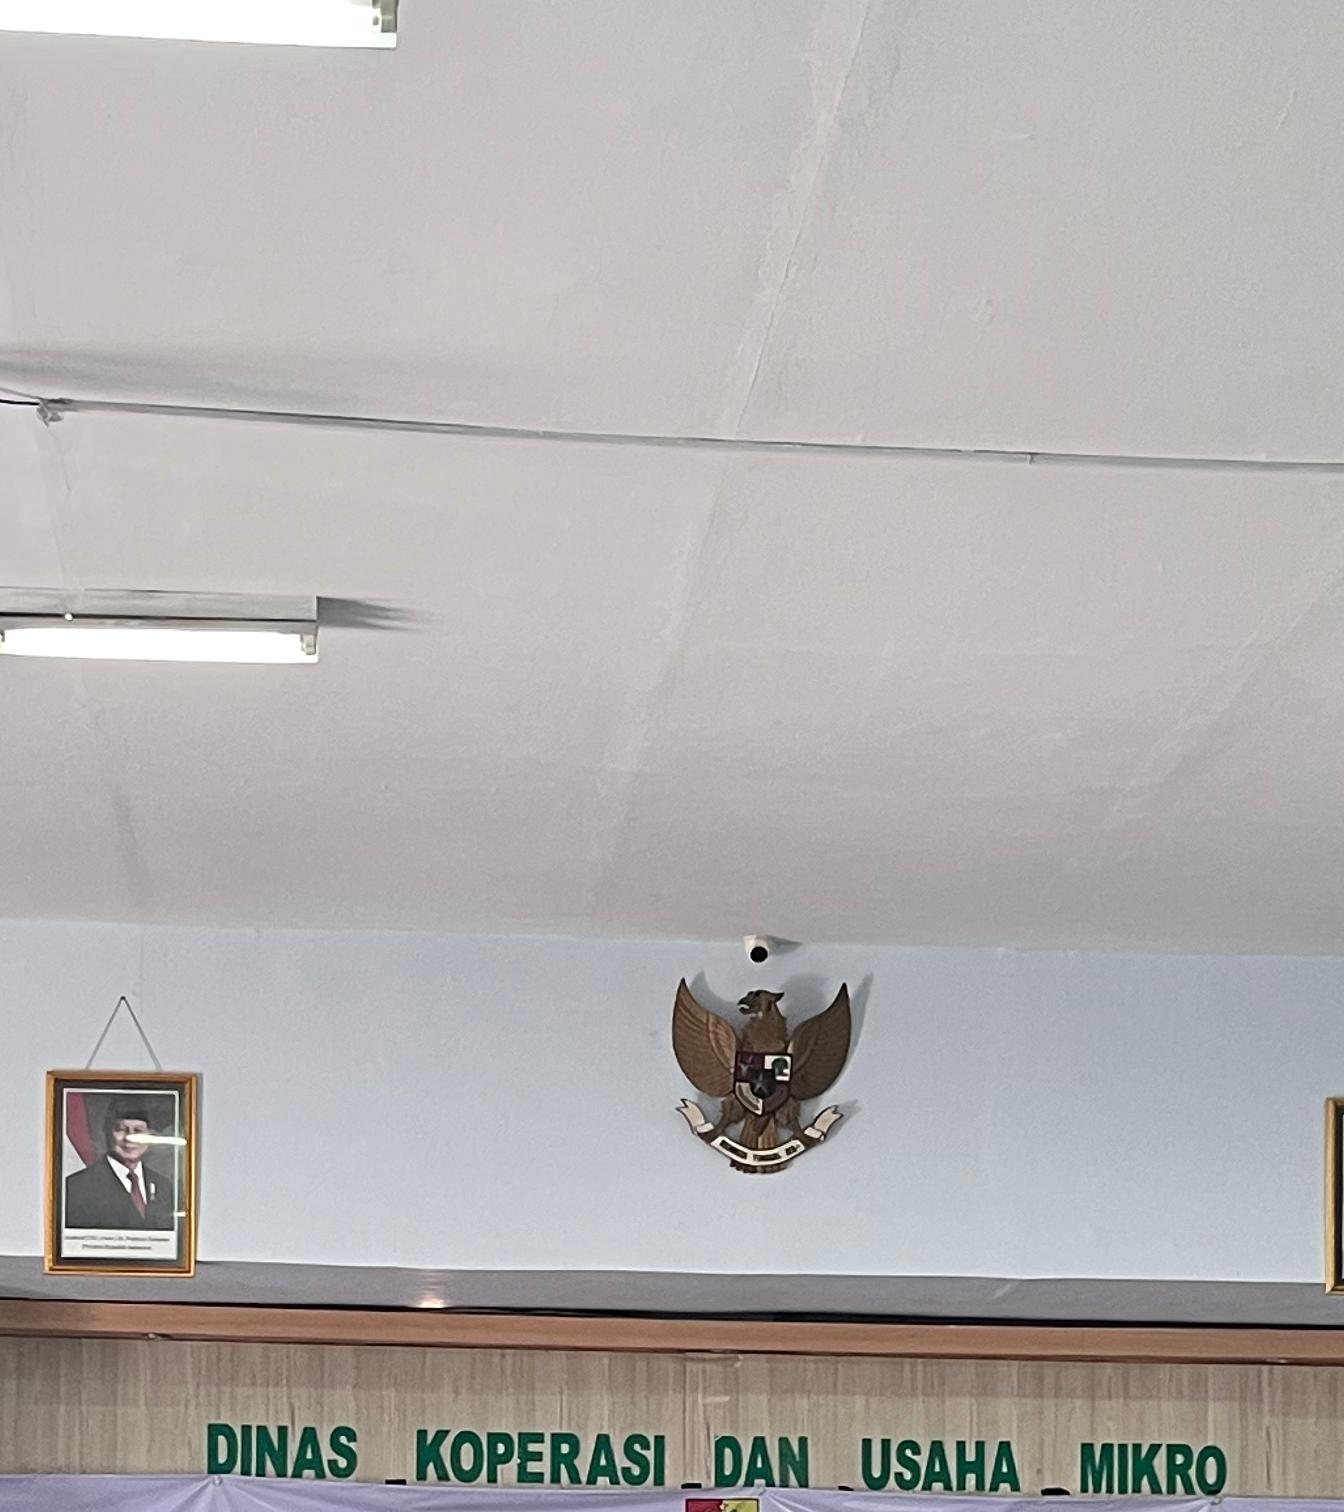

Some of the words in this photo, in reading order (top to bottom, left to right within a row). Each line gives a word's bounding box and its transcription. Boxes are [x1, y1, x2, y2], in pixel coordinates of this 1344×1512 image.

[206, 1423, 358, 1479] DINAS
[415, 1429, 666, 1487] KOPERASI
[714, 1435, 809, 1488] DAN
[861, 1438, 1021, 1493] USAHA
[1079, 1443, 1227, 1496] MIKRO
